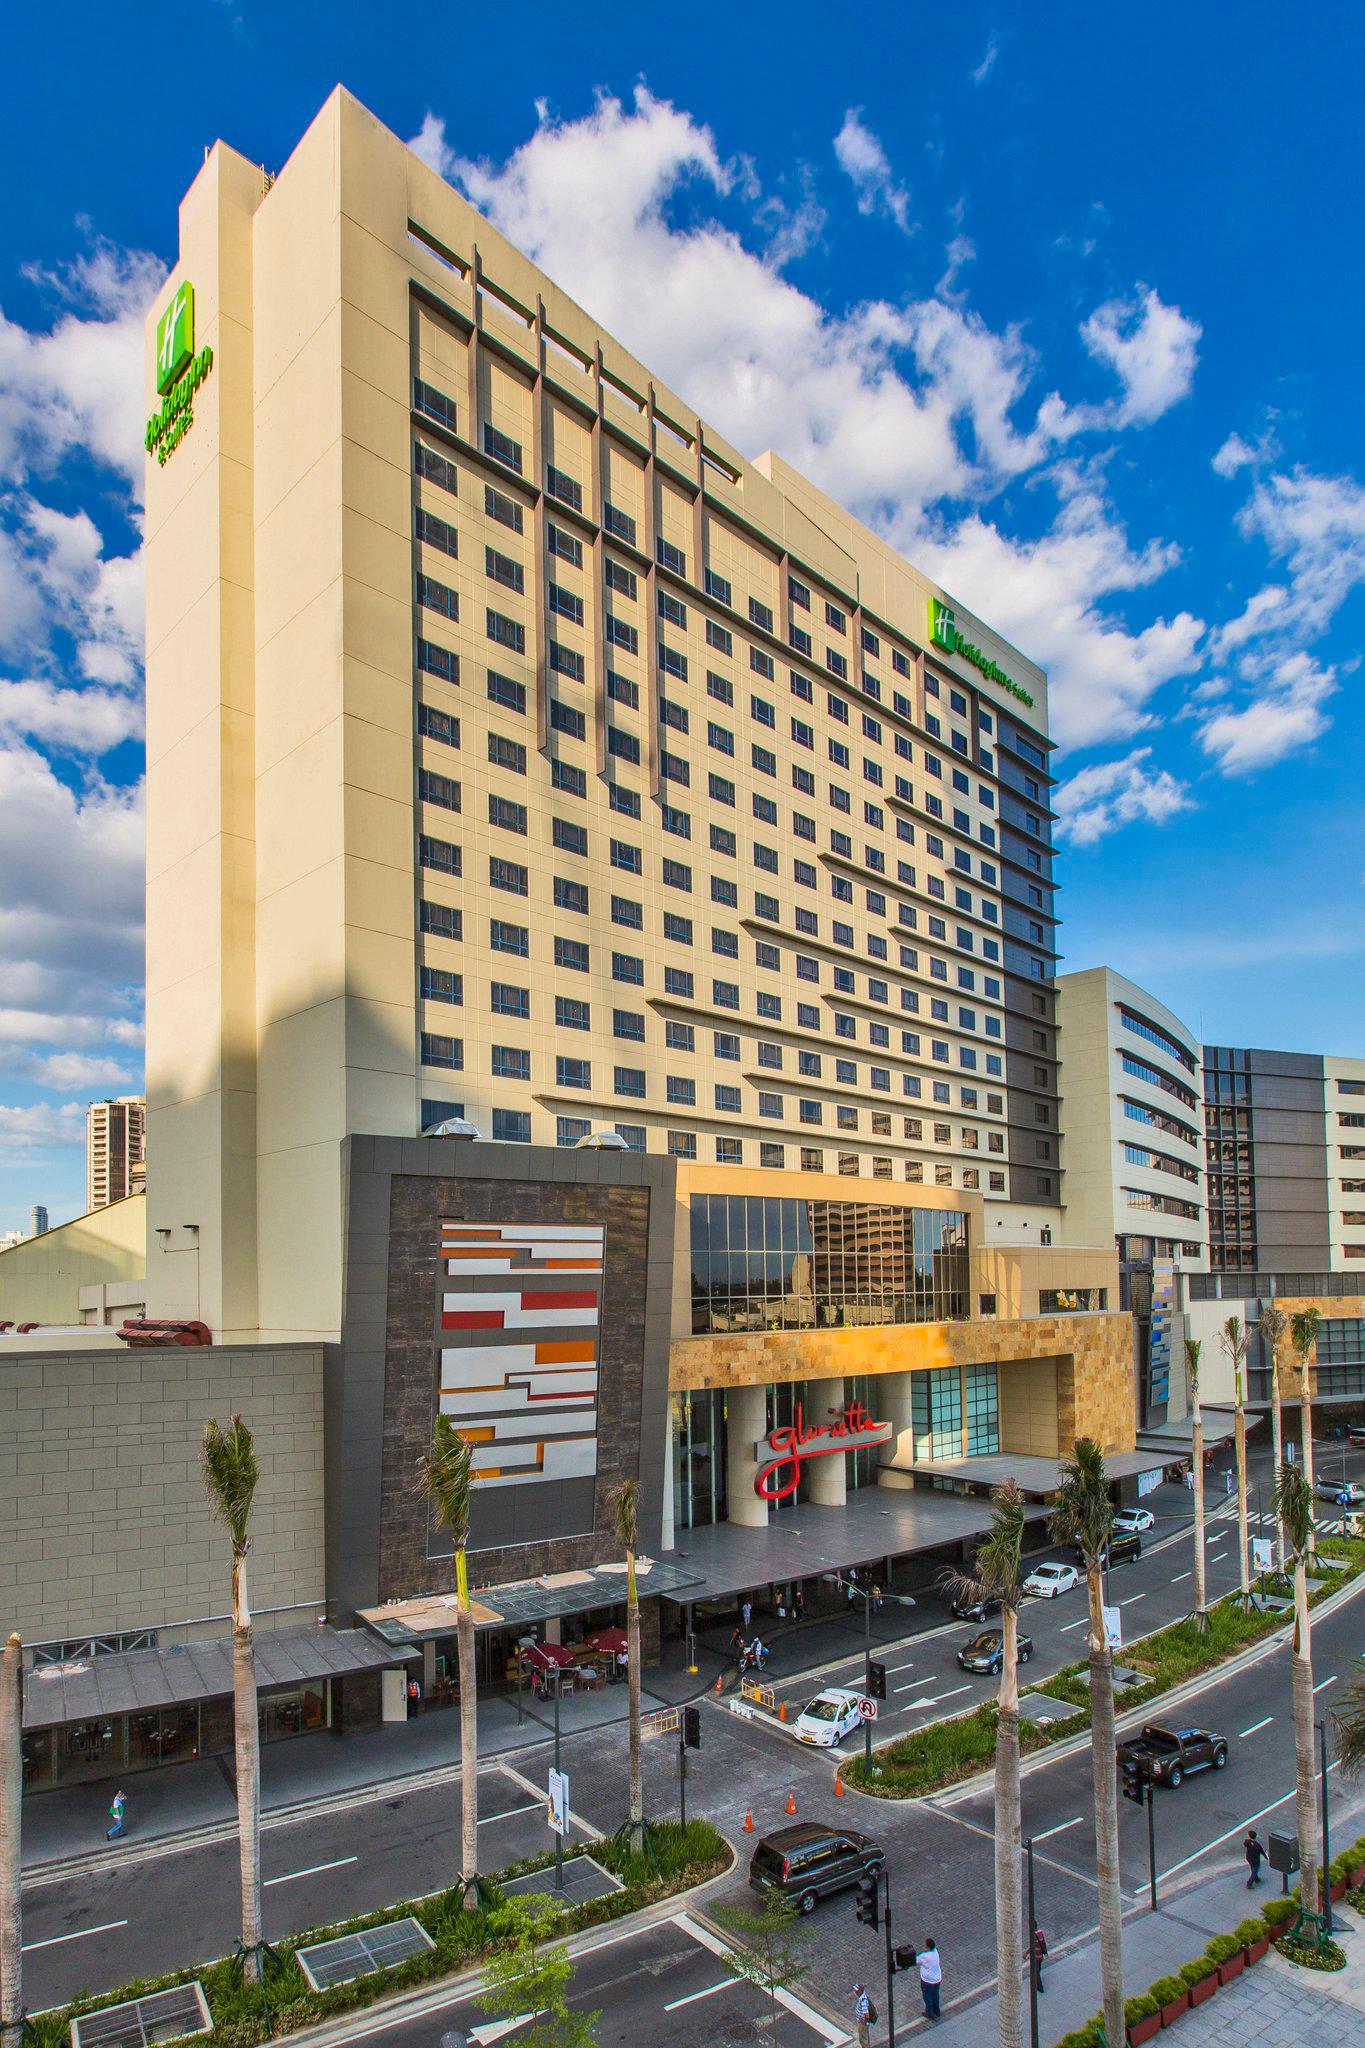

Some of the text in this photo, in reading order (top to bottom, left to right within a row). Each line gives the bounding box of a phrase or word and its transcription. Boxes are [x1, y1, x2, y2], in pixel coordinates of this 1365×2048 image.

[145, 379, 190, 453] Holiday
[954, 631, 991, 680] Holiday
[990, 660, 1006, 686] Inn
[754, 1400, 892, 1500] glorietta
